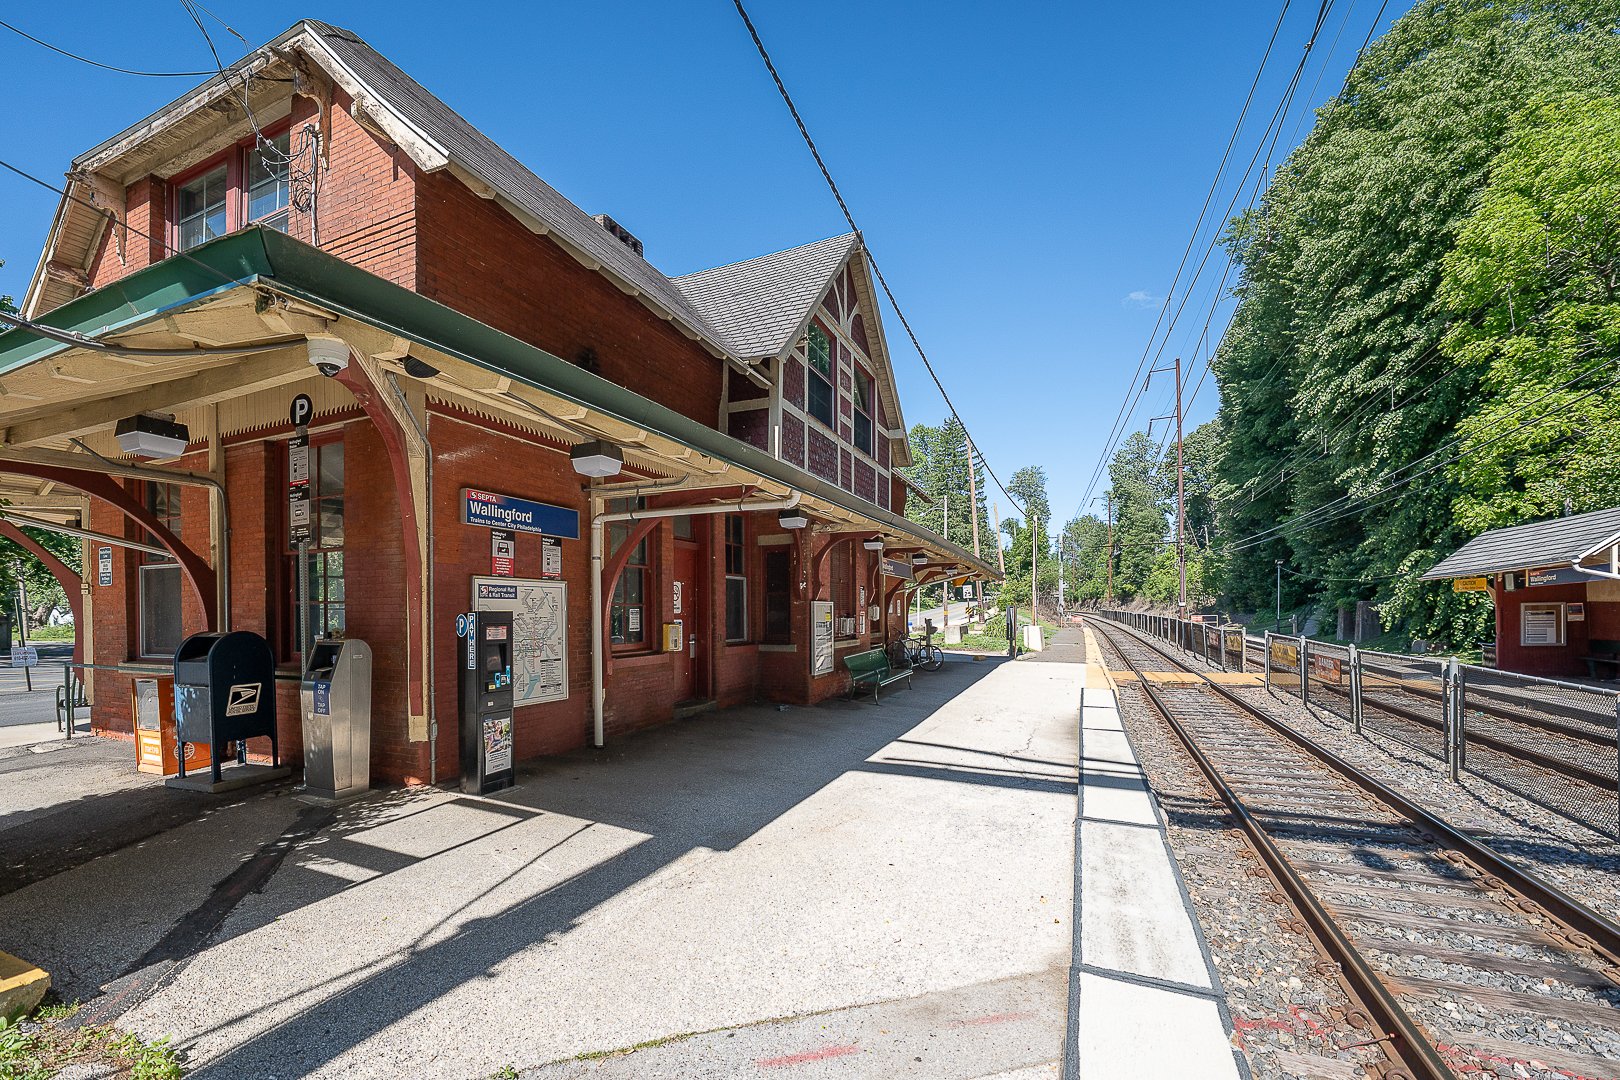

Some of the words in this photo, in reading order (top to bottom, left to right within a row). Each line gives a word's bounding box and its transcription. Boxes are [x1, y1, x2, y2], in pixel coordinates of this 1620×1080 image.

[296, 399, 308, 424] P
[477, 491, 497, 503] SEPTA
[469, 500, 532, 523] Wallingford
[470, 516, 485, 524] Trains
[491, 519, 507, 528] Center
[507, 522, 517, 530] City
[517, 524, 542, 533] Philadelphia
[1530, 574, 1557, 583] Wallingford
[459, 618, 464, 634] P
[144, 745, 159, 755] metro
